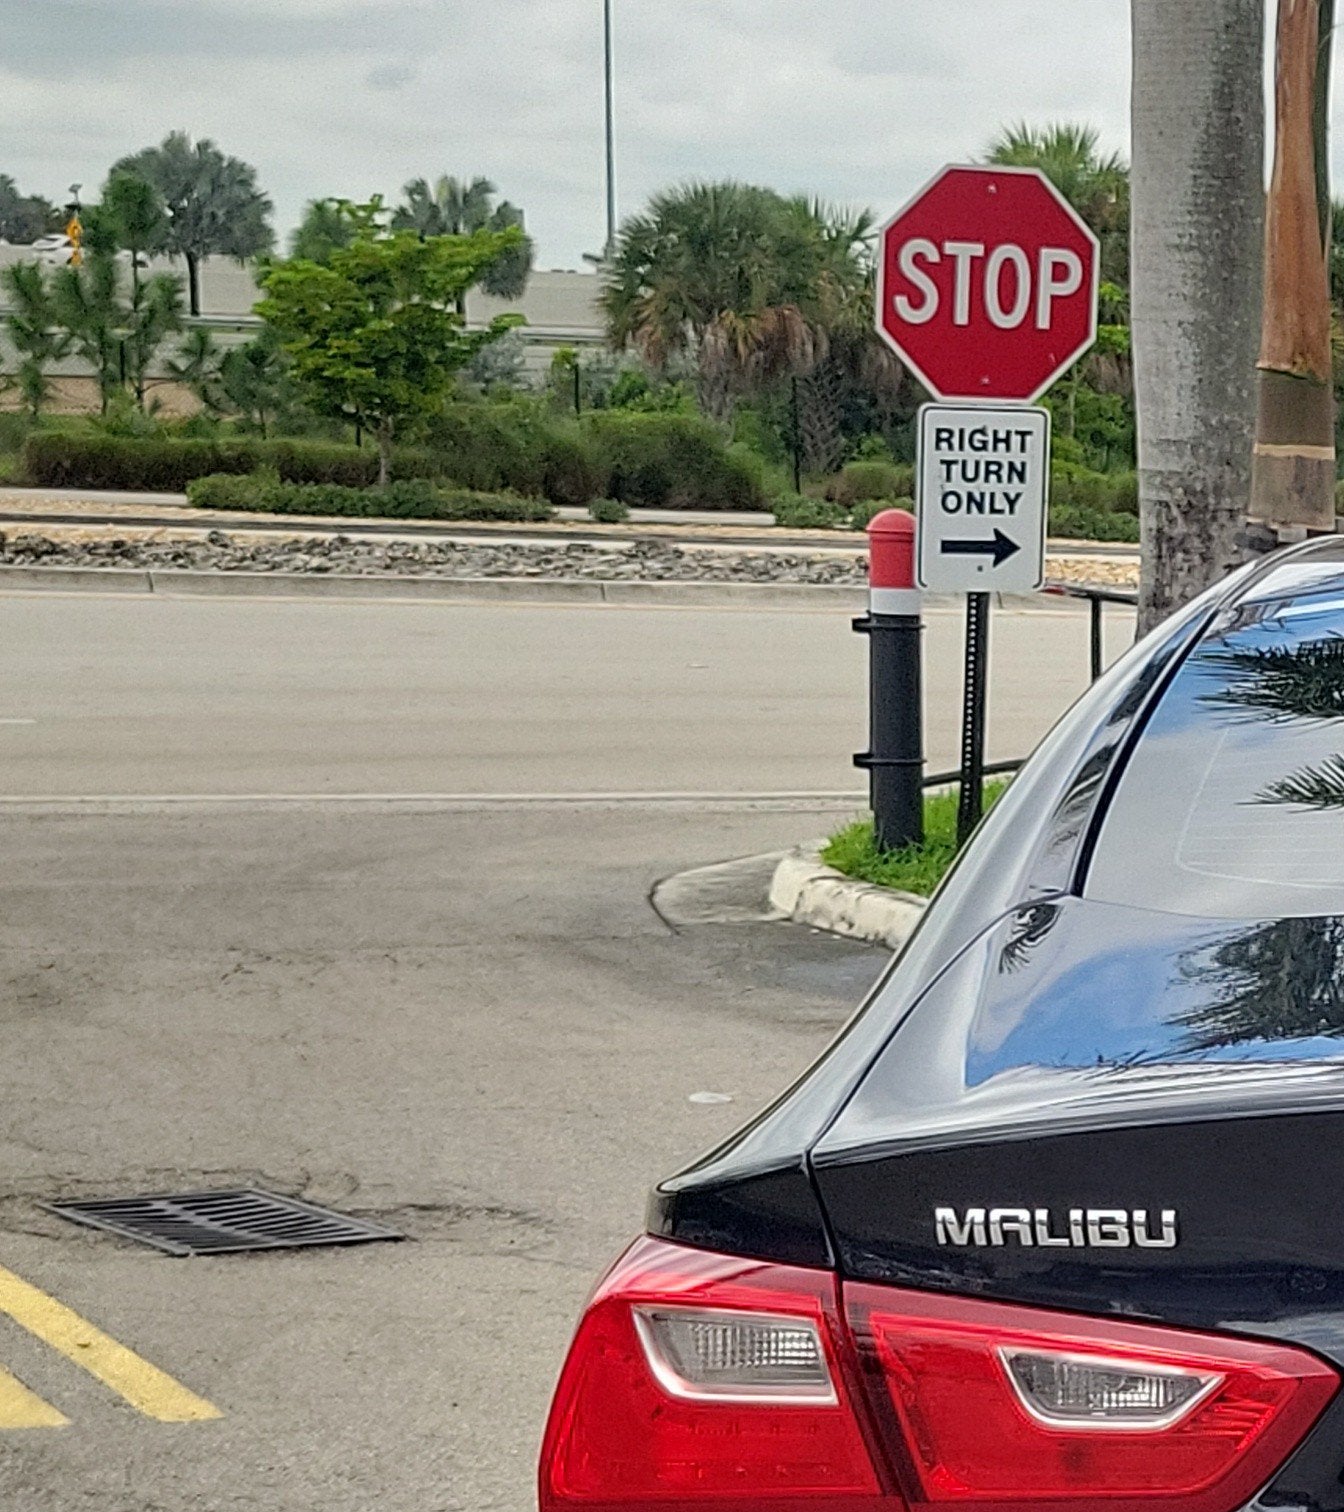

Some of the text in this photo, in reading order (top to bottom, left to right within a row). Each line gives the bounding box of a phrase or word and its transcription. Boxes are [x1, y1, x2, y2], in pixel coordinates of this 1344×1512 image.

[894, 237, 1083, 330] STOP
[934, 426, 1034, 454] RIGHT
[939, 458, 1028, 485] TURN
[940, 490, 1023, 516] ONLY
[934, 1206, 1178, 1249] MALIBU
